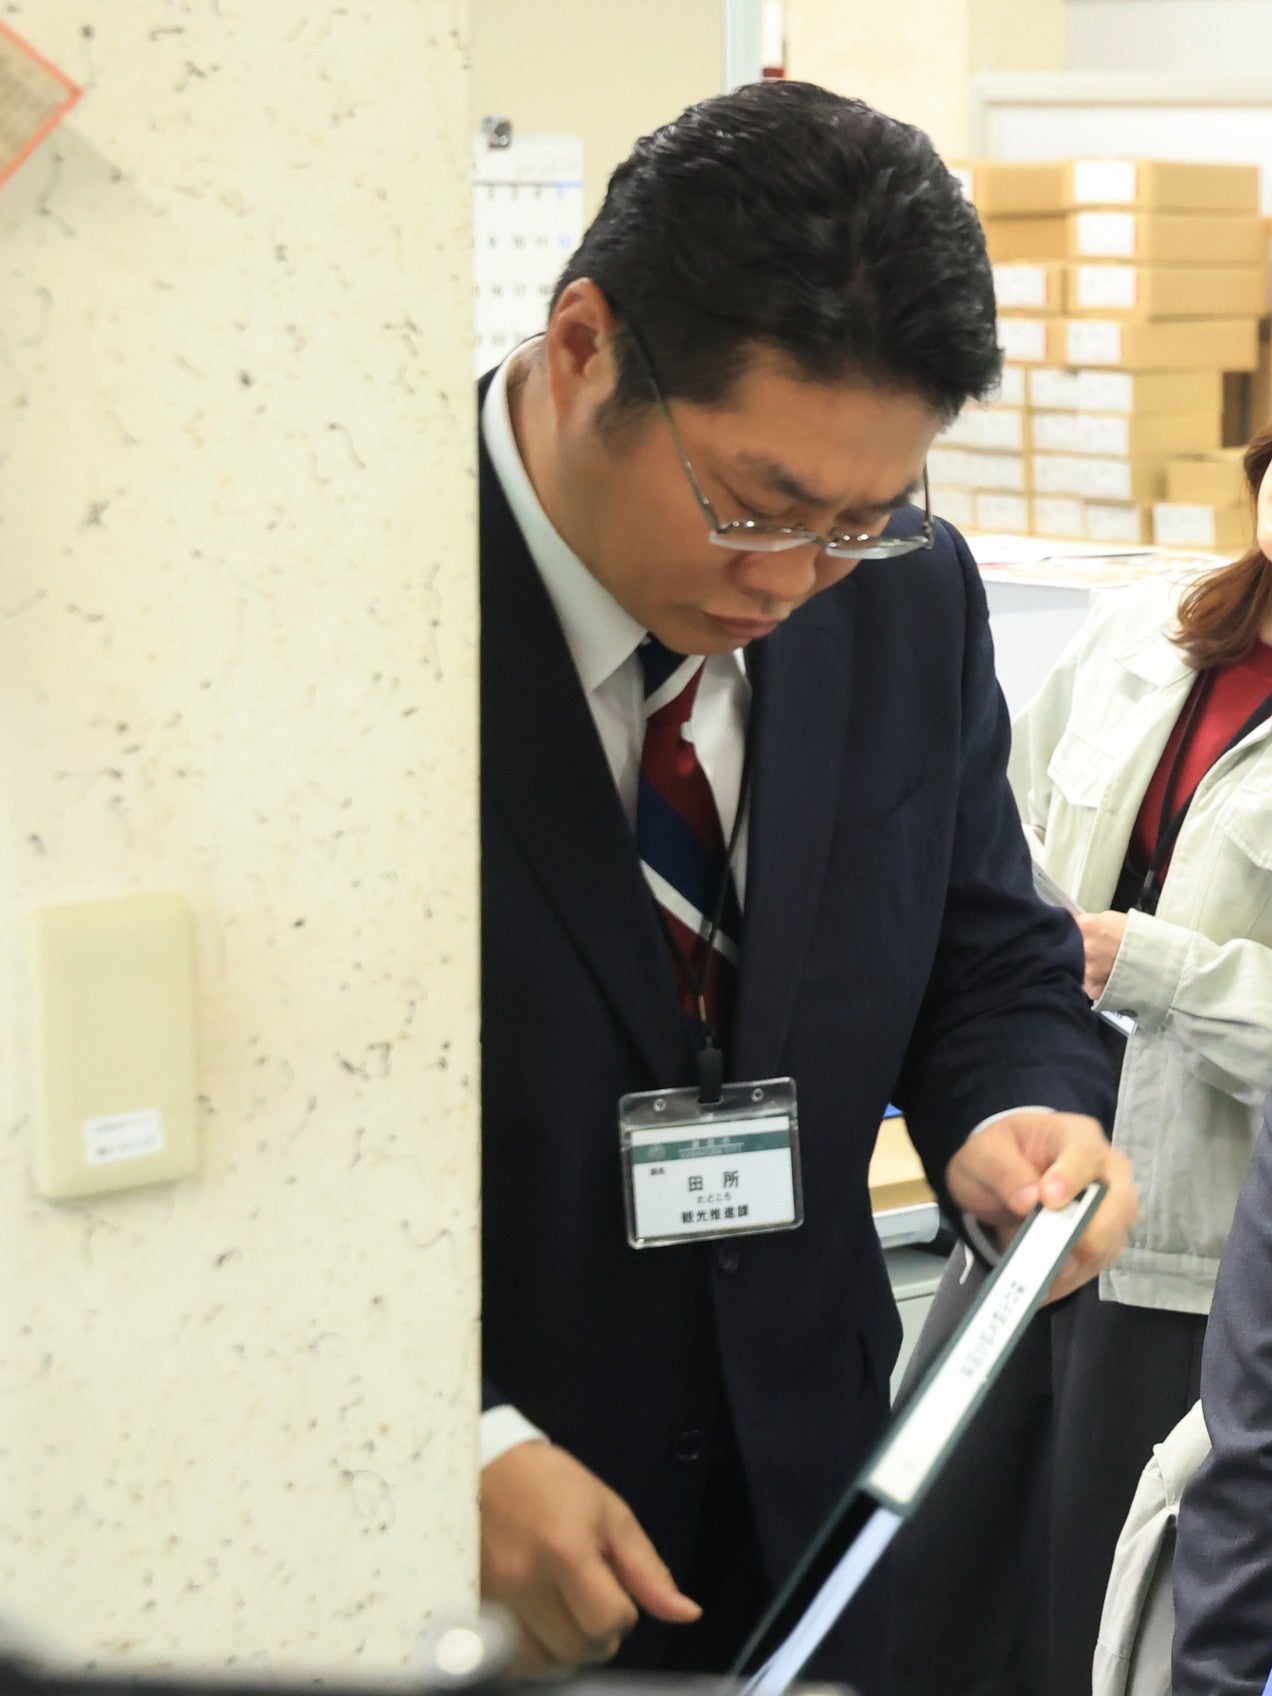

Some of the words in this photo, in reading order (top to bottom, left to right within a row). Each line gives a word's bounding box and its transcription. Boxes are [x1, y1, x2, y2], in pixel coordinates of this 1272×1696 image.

[687, 1170, 740, 1192] 田所
[681, 1204, 750, 1224] 観光推進課
